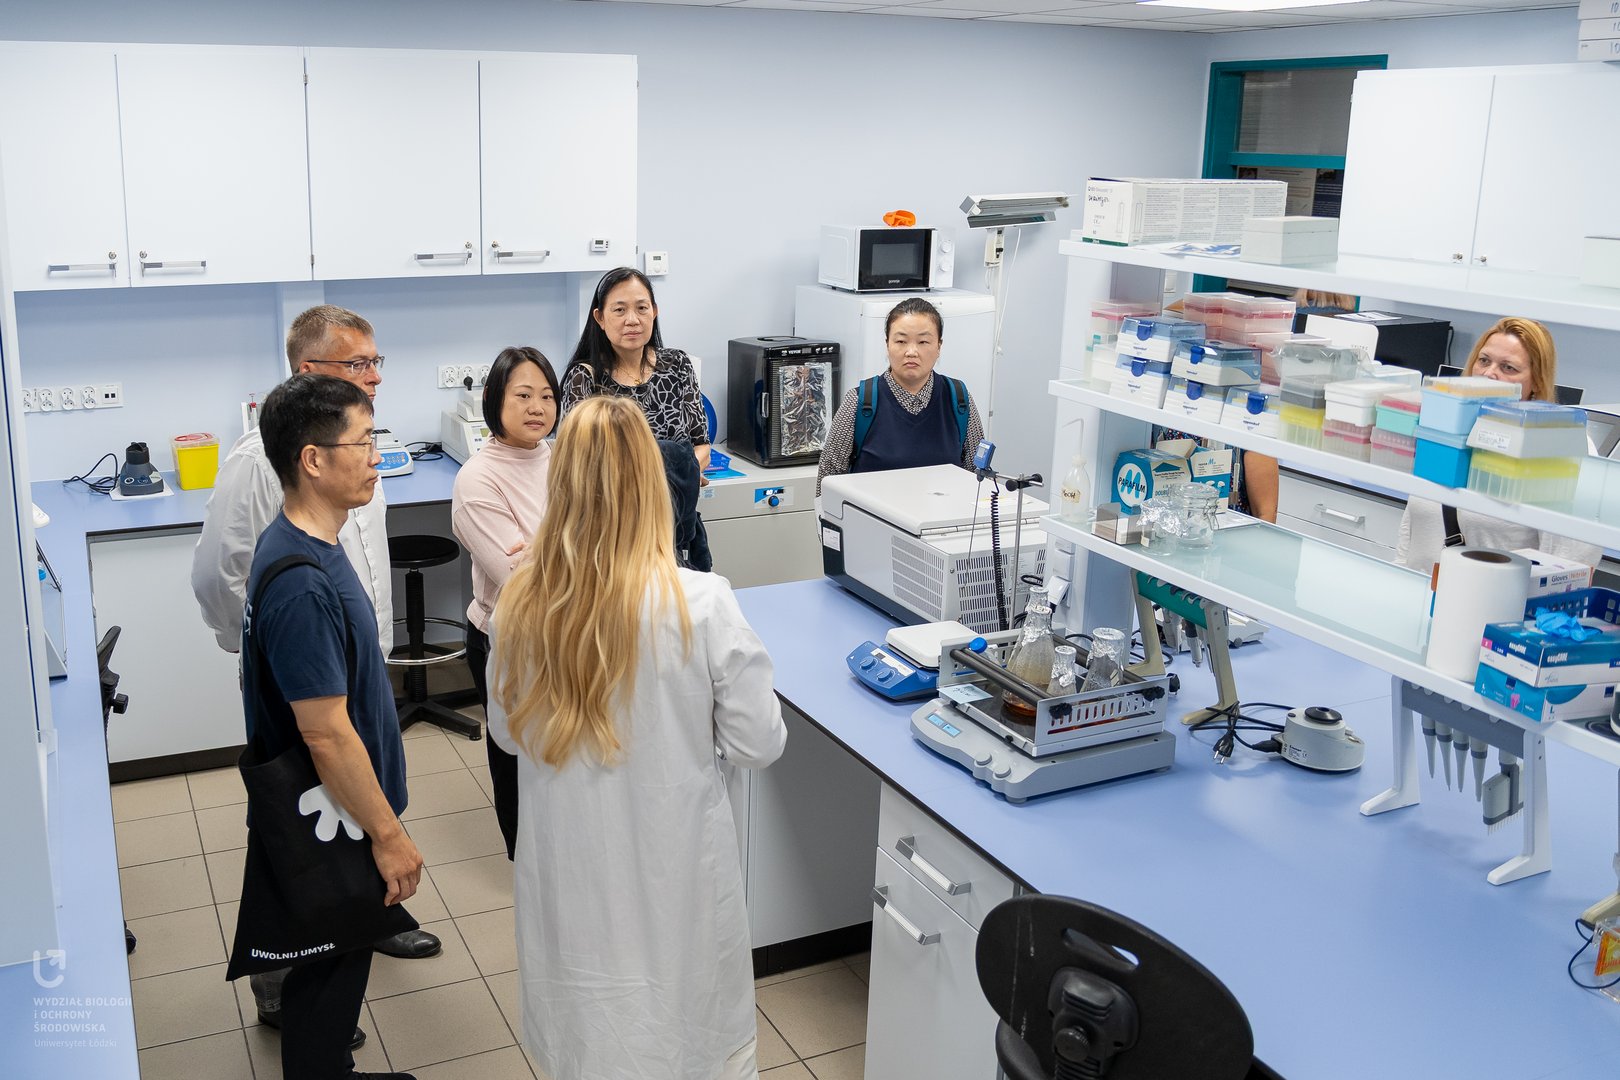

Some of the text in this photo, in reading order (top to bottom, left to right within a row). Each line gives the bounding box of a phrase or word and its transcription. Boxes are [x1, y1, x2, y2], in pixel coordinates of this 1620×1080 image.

[1118, 476, 1146, 494] PARAFILM
[1570, 570, 1587, 579] Nitrile
[251, 943, 336, 960] UWOLNIJ UMYSŁ
